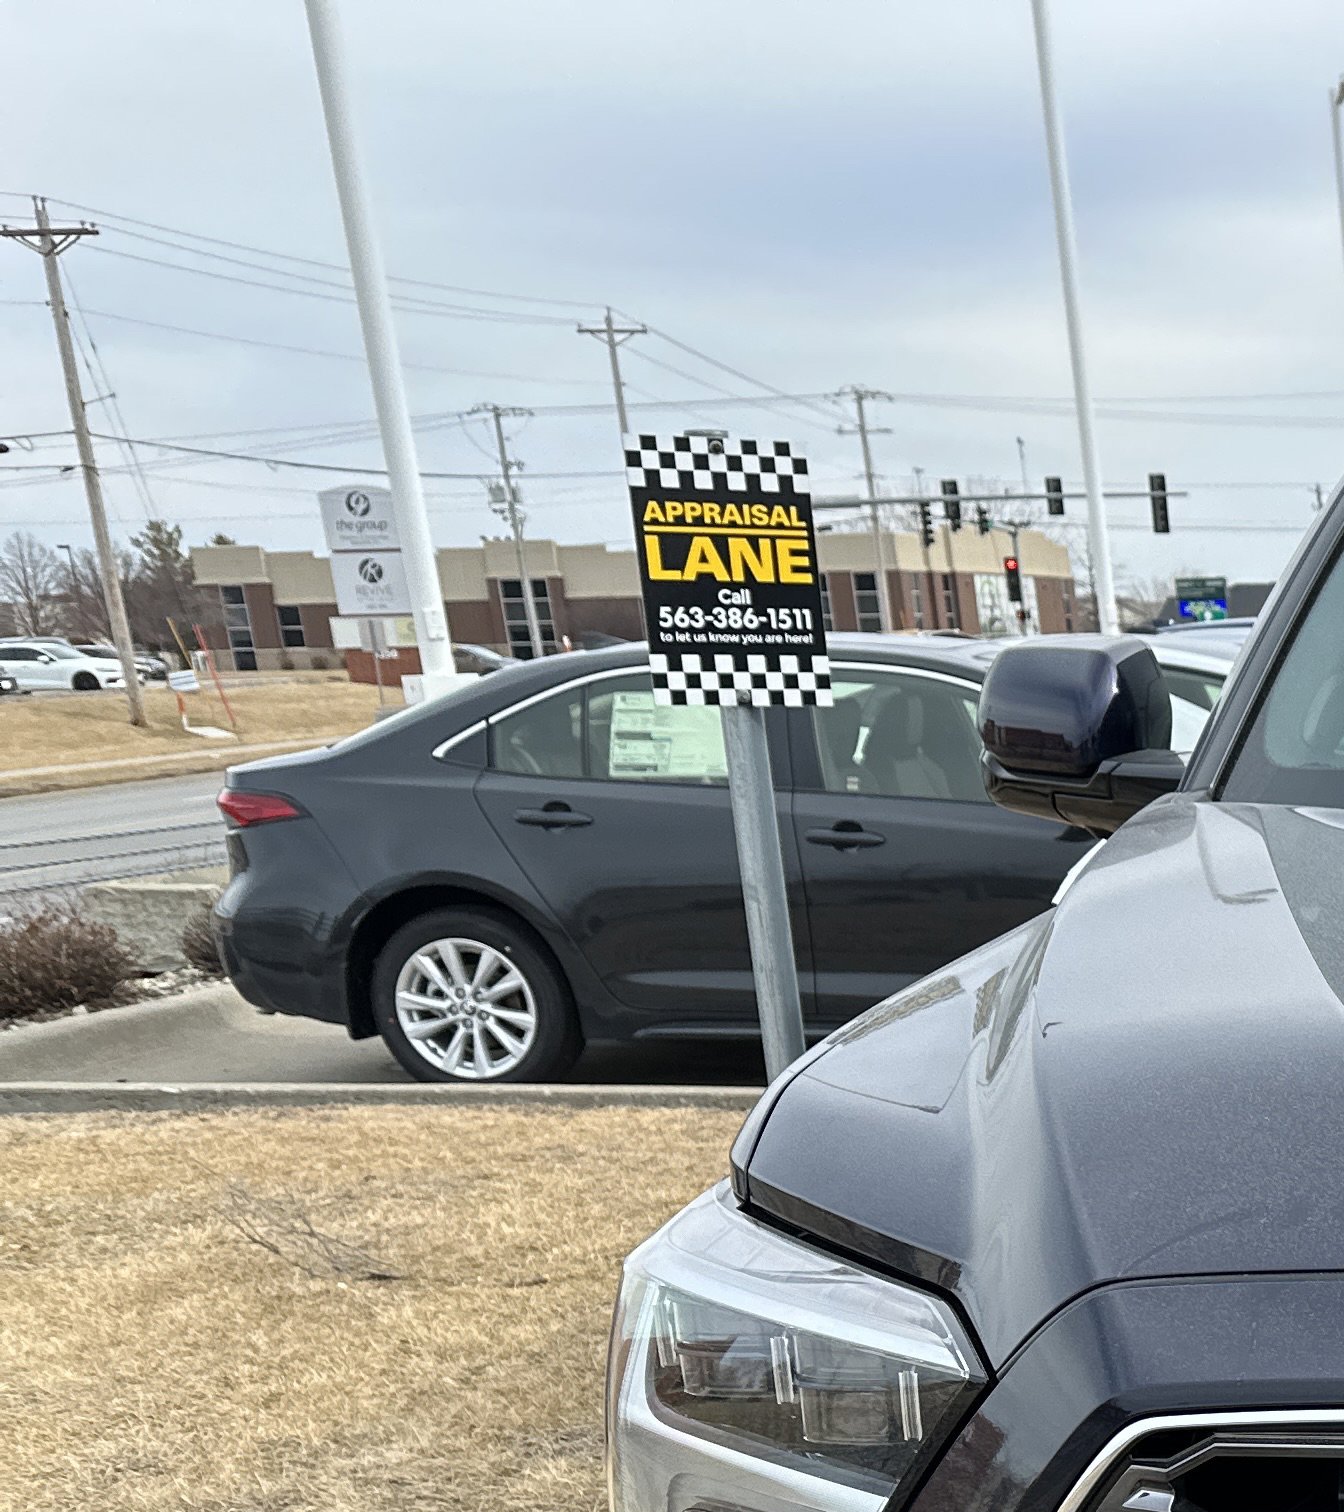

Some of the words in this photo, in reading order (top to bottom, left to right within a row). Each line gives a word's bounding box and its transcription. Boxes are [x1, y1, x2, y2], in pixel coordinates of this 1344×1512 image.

[643, 500, 807, 527] APPRAISAL
[355, 519, 388, 534] group
[644, 534, 814, 584] LANE
[717, 588, 752, 605] Call
[658, 605, 813, 630] 563-386-1511
[660, 631, 674, 643] to
[675, 631, 692, 643] let
[693, 633, 707, 643] us
[708, 632, 740, 644] know
[742, 634, 763, 646] you
[764, 633, 783, 644] are
[785, 633, 814, 644] here!
